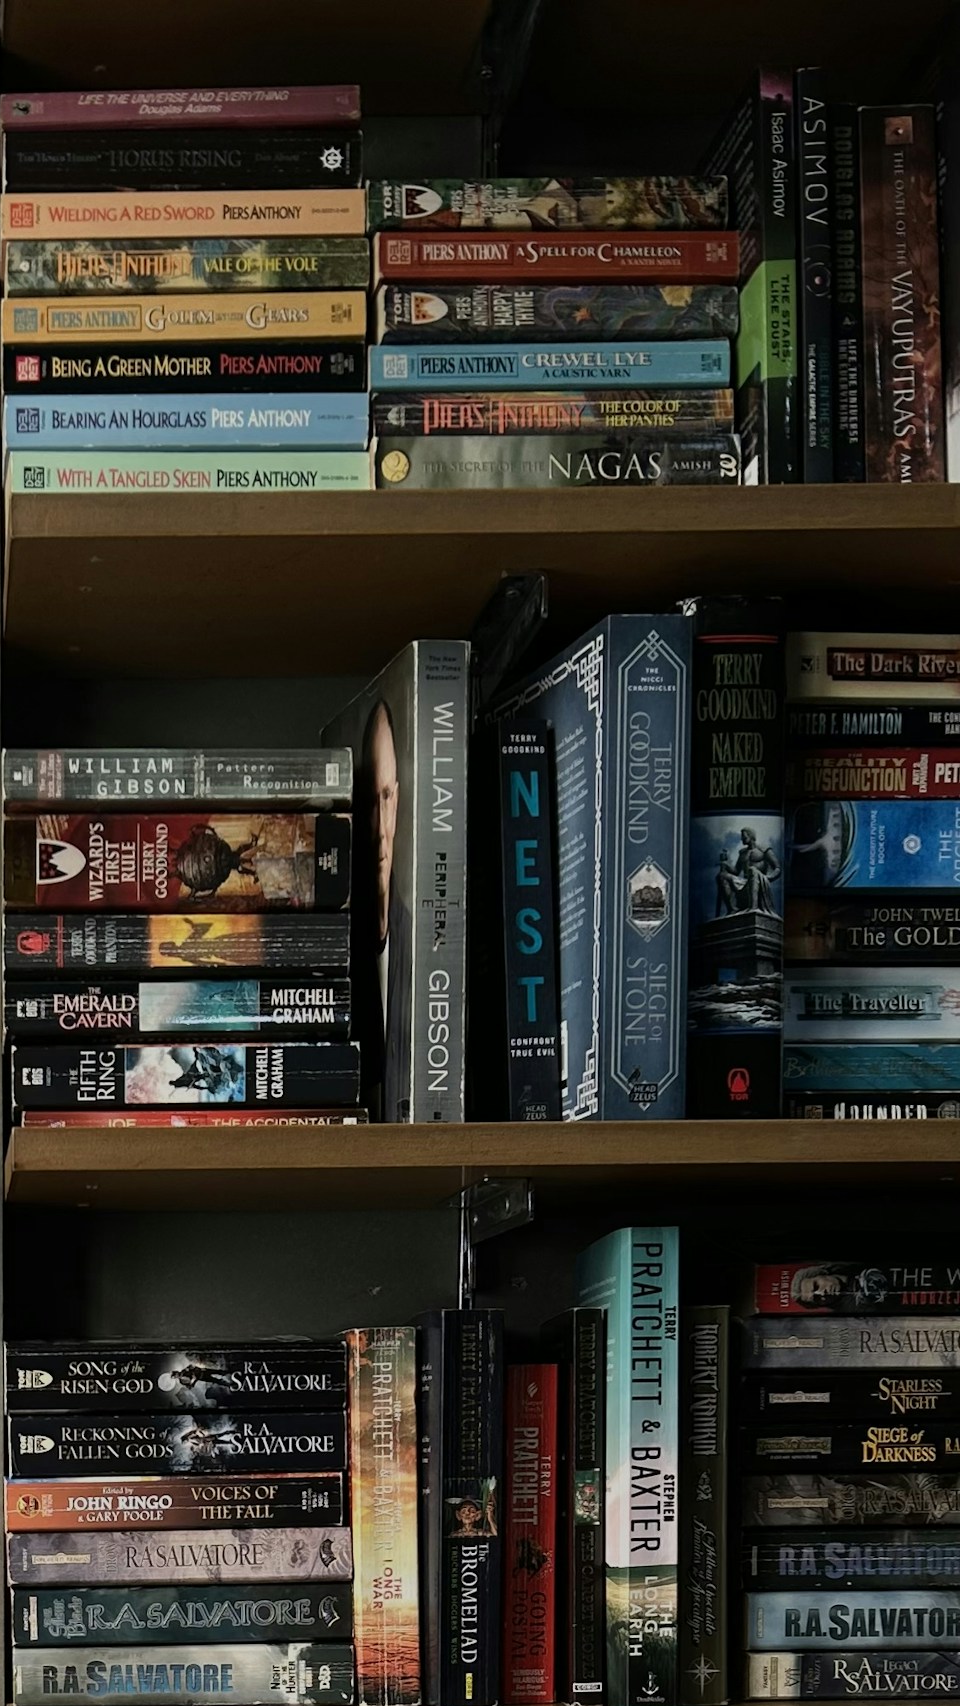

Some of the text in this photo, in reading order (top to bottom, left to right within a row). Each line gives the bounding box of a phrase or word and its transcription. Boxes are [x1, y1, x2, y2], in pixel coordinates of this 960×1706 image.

[769, 111, 788, 218] Isaac Asimov
[802, 96, 829, 226] ASIMOV
[49, 205, 301, 222] WIELDING A RED SWORD PIERS ANTHONY
[52, 353, 323, 378] BEING A GREEN MOTHER PIERS ANTHONY
[890, 270, 916, 438] VAYUPUTRAS
[549, 452, 712, 481] NAGAS AMISH
[69, 758, 173, 774] WILLIAM
[432, 702, 455, 834] WILLIAM
[97, 779, 186, 795] GIBSON
[88, 822, 104, 902] WIZARD'S
[105, 841, 120, 884] FIRST
[122, 841, 136, 882] RULE
[509, 770, 545, 1023] NEST
[53, 994, 136, 1013] EMERALD
[271, 989, 336, 1005] MITCHELL
[810, 995, 926, 1013] The Traveller
[59, 1013, 132, 1030] CAVERN
[272, 1008, 335, 1023] GRAHAM
[427, 969, 451, 1092] GIBSON
[78, 1051, 96, 1102] FIFTH
[97, 1051, 115, 1101] RING
[631, 1242, 663, 1554] PRATCHETT & BAXTER
[878, 1378, 943, 1400] STARLESS
[664, 1306, 676, 1522] TERRY STEPHEN
[891, 1396, 938, 1415] NIGHT
[67, 1495, 173, 1511] JOHN RINGO
[191, 1486, 278, 1501] VOICES OF
[200, 1505, 274, 1520] THE FALL
[479, 1544, 489, 1562] The
[461, 1545, 479, 1664] BROMELIAD
[43, 1661, 233, 1696] R.A. SALVATORE
